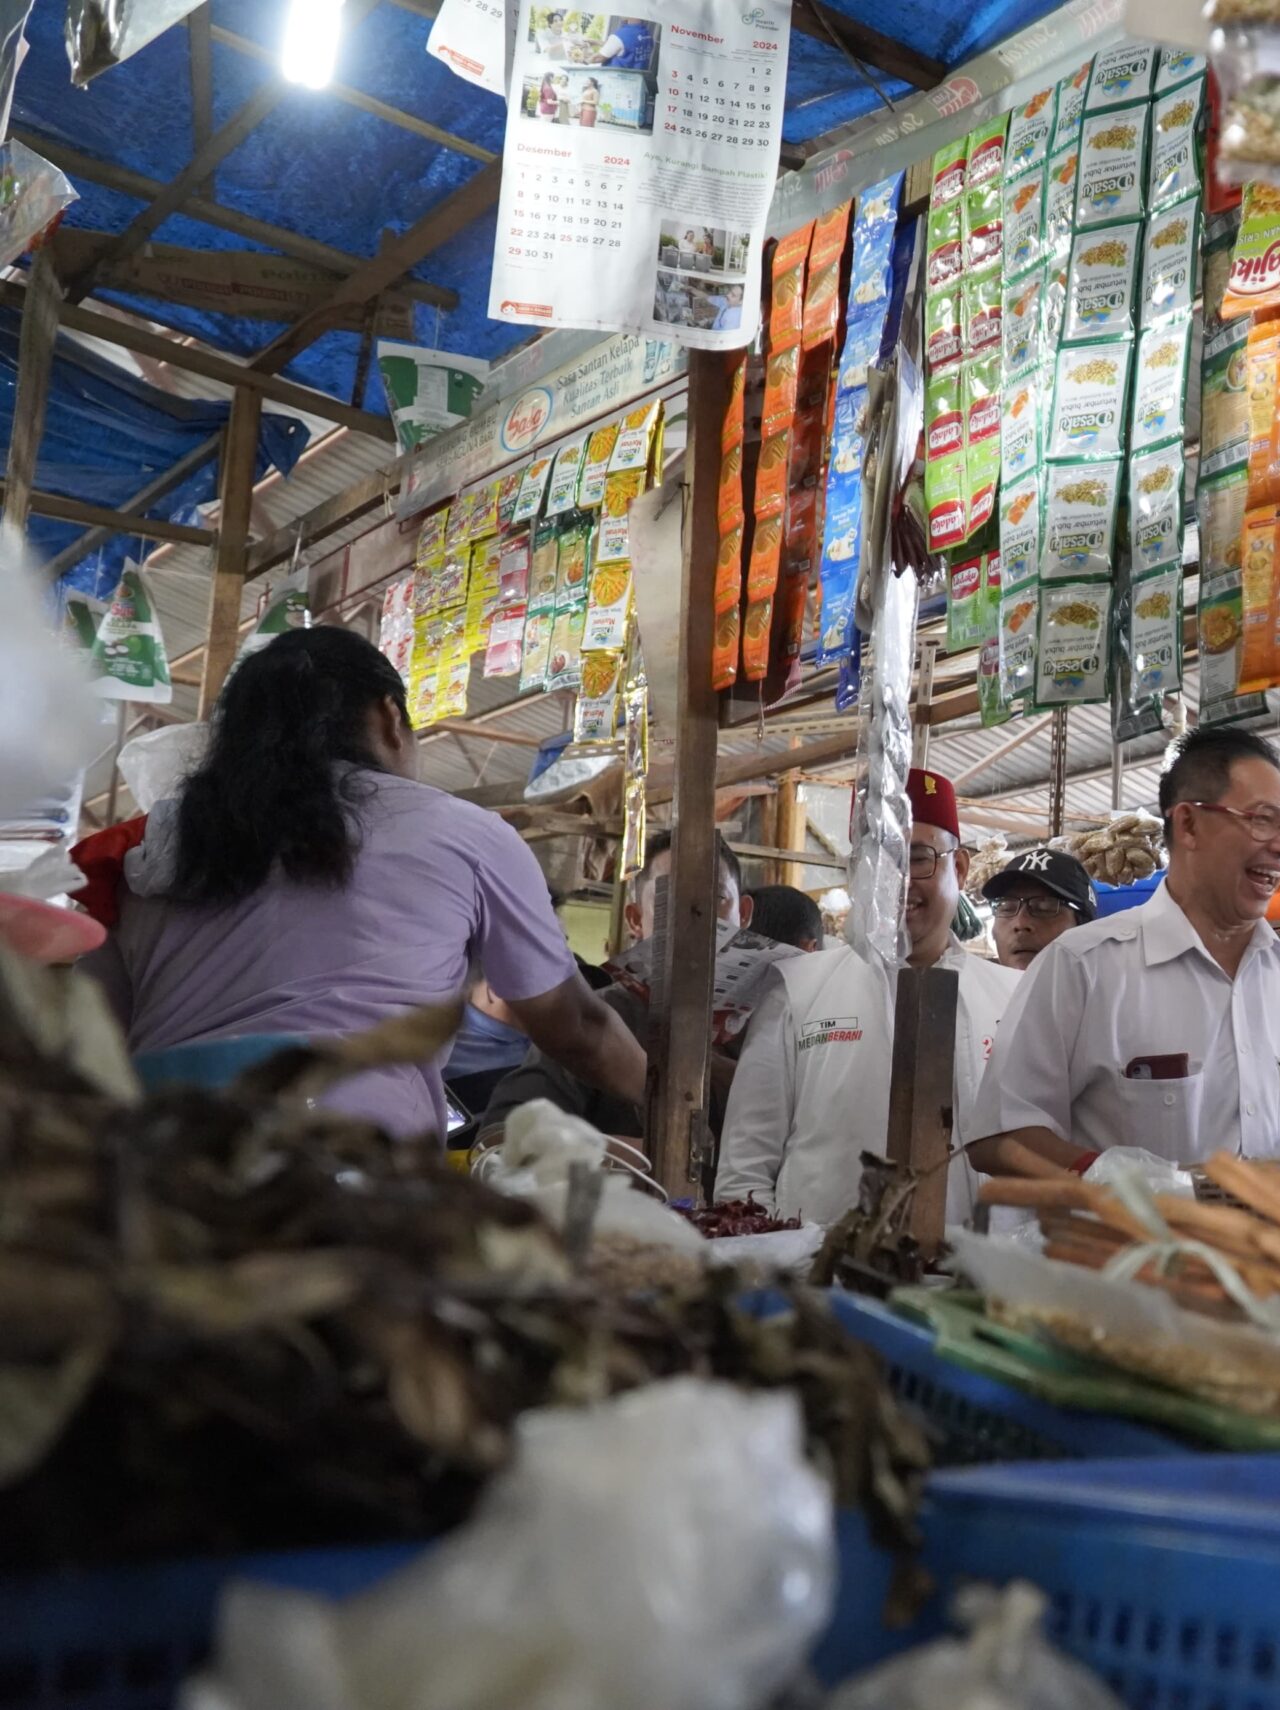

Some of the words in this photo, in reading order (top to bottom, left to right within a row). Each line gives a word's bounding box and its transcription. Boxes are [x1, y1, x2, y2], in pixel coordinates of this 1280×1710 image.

[490, 8, 503, 18] 29
[671, 25, 724, 43] November
[753, 41, 778, 50] 2024
[1095, 58, 1147, 85] Desaku
[668, 88, 679, 96] 10
[667, 105, 677, 113] 17
[683, 109, 693, 117] 18
[729, 118, 739, 126] 21
[664, 122, 677, 131] 24
[680, 126, 692, 135] 25
[695, 130, 707, 138] 26
[711, 133, 723, 141] 27
[727, 136, 739, 144] 28
[742, 138, 754, 146] 29
[517, 143, 572, 158] Desember
[604, 155, 630, 166] 2024
[1104, 161, 1136, 174] ketumbar
[1084, 167, 1101, 178] bubuk
[1082, 173, 1135, 199] Desaku
[513, 209, 524, 217] 15
[594, 219, 607, 227] 20
[611, 221, 622, 229] 21
[510, 228, 524, 236] 22
[527, 231, 539, 239] 23
[560, 234, 572, 242] 25
[576, 235, 589, 243] 26
[593, 237, 605, 245] 27
[609, 239, 621, 247] 28
[508, 246, 521, 255] 29
[525, 249, 538, 257] 30
[1094, 278, 1127, 290] ketumbar
[1077, 291, 1124, 314] Desak
[578, 355, 608, 379] Santan
[609, 337, 640, 359] Kelapa
[600, 358, 634, 384] Terbaik
[571, 395, 600, 417] Santan
[604, 381, 620, 401] Asli
[1061, 402, 1081, 411] bubuk
[1085, 398, 1117, 408] ketumbar
[1060, 411, 1114, 433] Desaku
[1073, 519, 1107, 529] ketumbar
[1050, 530, 1104, 551] Desaku
[1044, 656, 1098, 676] Desaku
[820, 1021, 836, 1029] TIM
